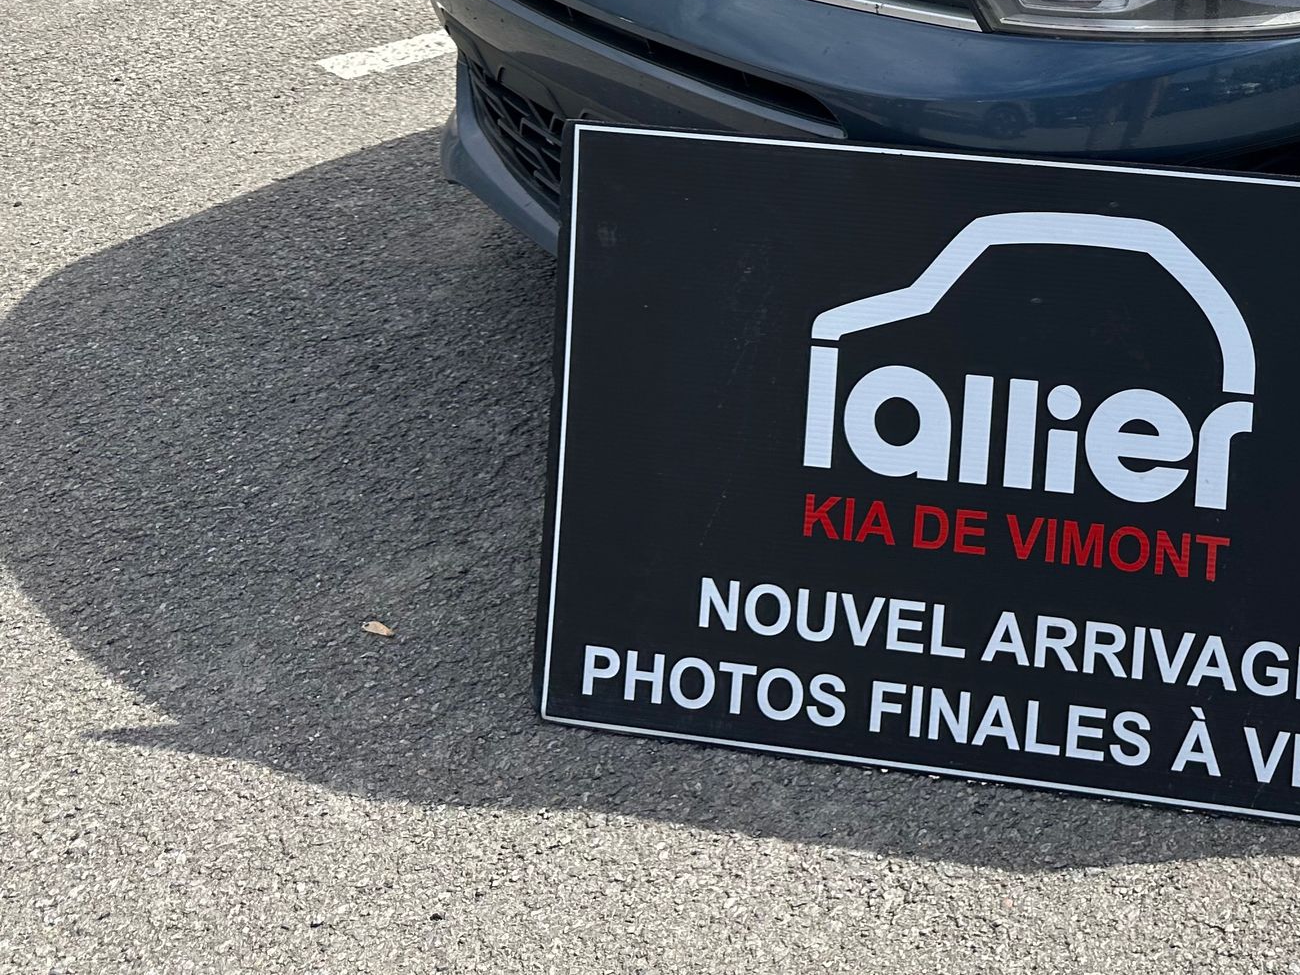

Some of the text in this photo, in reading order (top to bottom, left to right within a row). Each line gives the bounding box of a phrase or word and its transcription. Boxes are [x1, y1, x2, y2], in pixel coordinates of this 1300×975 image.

[803, 493, 1231, 583] KIA DE VIMONT
[698, 577, 966, 659] NOUVEL
[581, 644, 847, 727] PHOTOS
[869, 680, 1151, 768] FINALES
[1170, 706, 1222, 777] À
